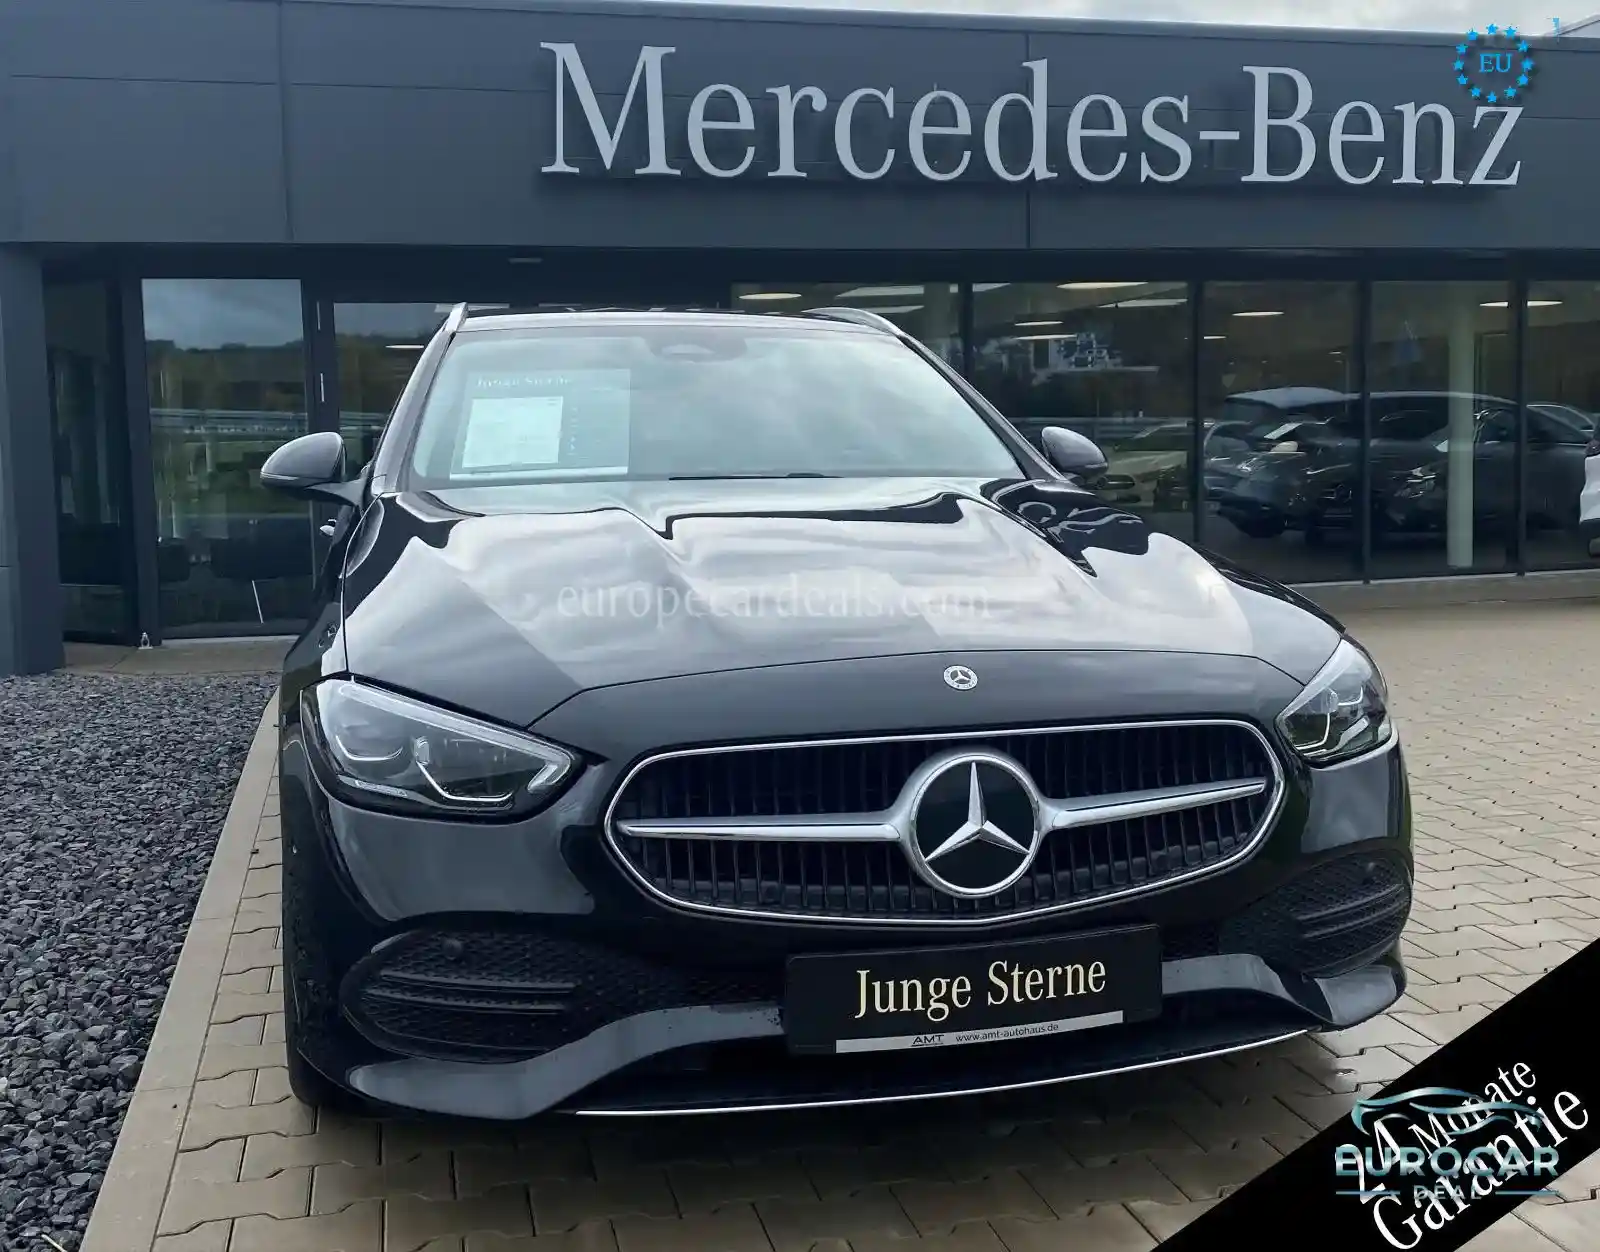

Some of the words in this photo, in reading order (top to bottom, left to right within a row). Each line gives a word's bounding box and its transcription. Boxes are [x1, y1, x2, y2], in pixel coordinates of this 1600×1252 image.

[539, 41, 1523, 187] Mercedes-Benz
[855, 968, 972, 1022] Junge
[987, 959, 1107, 1006] Sterne
[911, 1033, 944, 1046] AMT
[955, 1023, 1059, 1042] www.amt-autohaus.de
